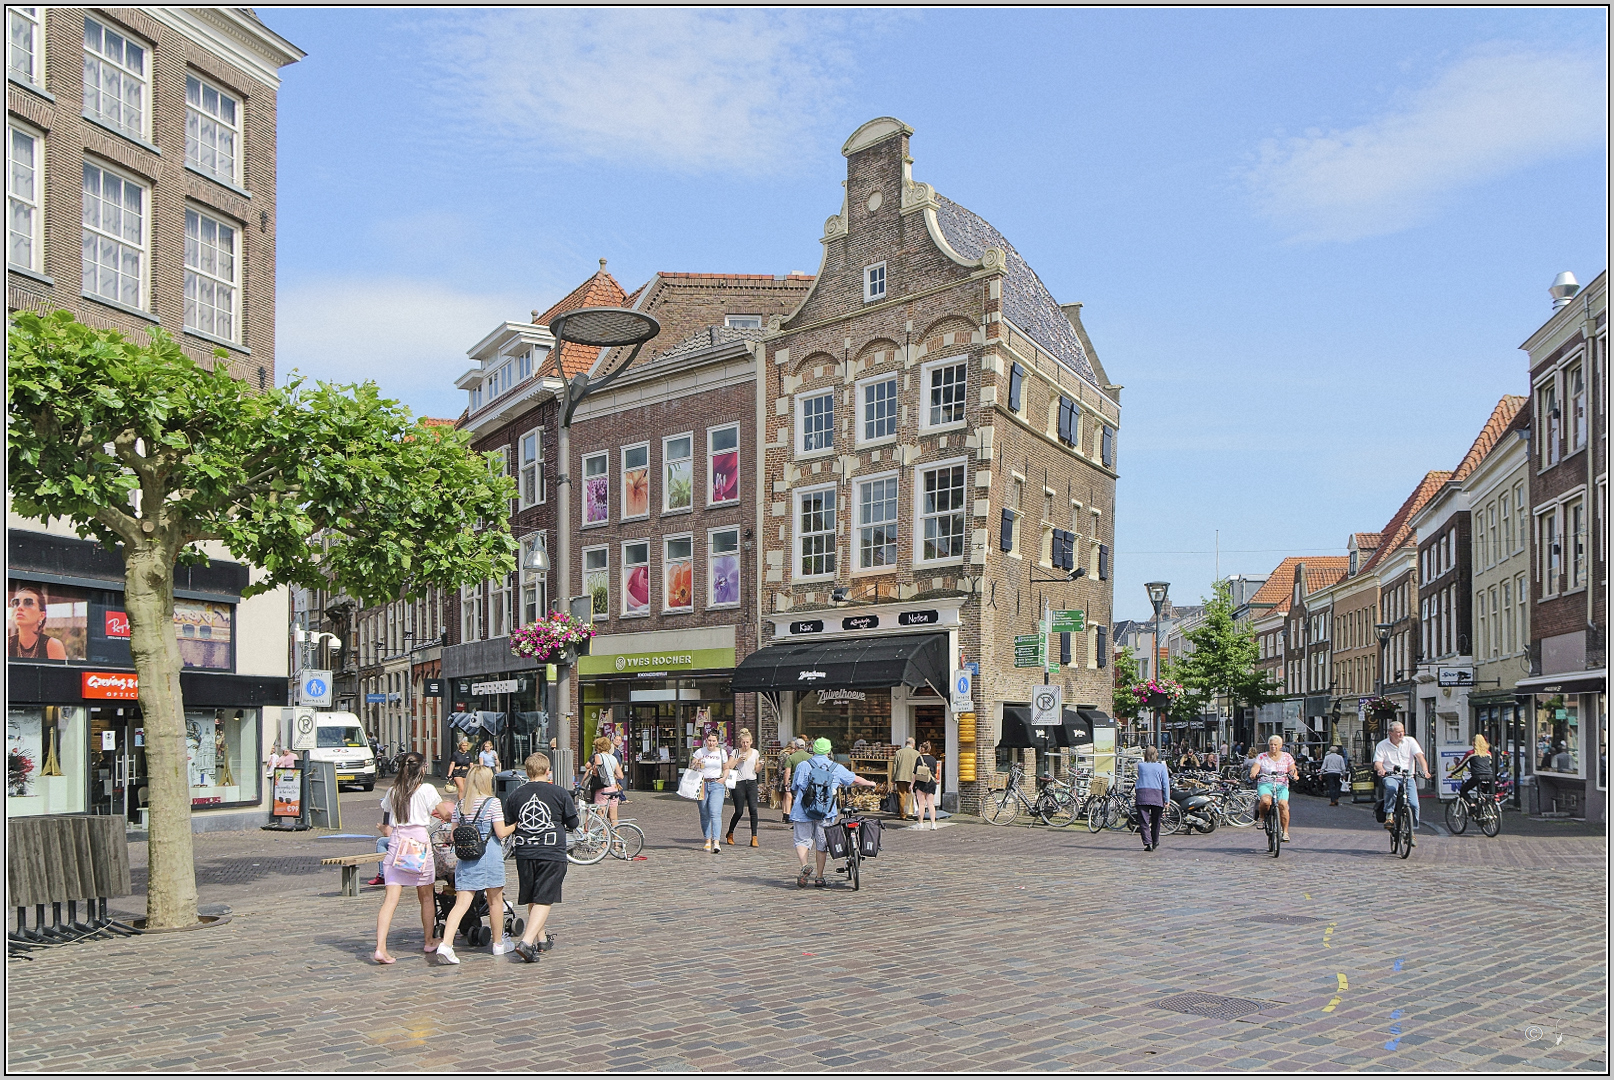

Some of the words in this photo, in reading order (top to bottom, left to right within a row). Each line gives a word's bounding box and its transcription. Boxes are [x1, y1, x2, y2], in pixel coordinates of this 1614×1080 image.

[908, 613, 929, 623] Noten
[627, 657, 650, 667] YVES
[652, 655, 692, 666] ROCHER
[817, 688, 866, 705] Zuivelhoeve
